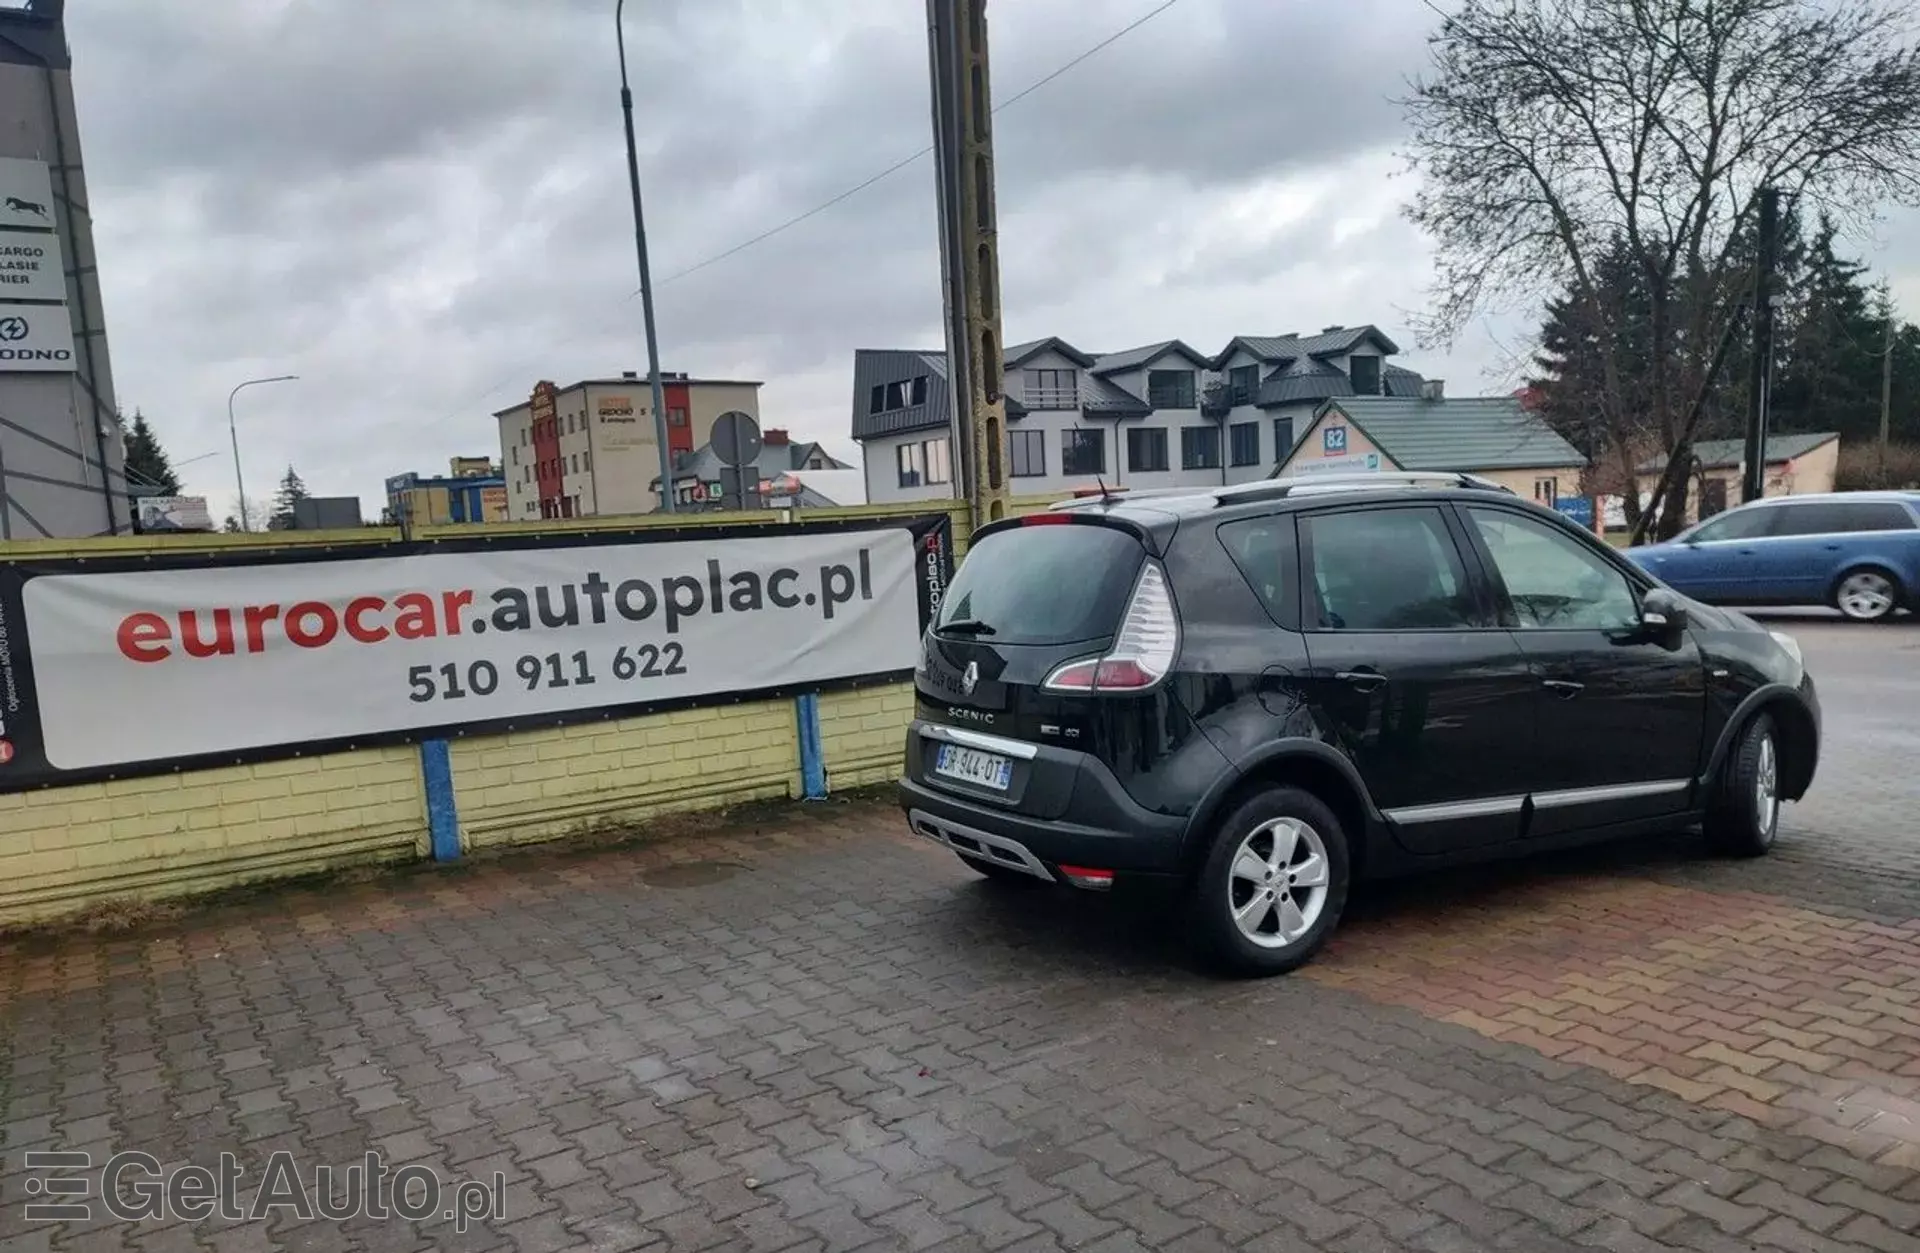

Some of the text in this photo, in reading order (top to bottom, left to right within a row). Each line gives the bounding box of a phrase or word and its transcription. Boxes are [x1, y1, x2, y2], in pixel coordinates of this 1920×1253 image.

[1327, 430, 1344, 448] 82
[117, 548, 873, 662] eurocar.autoplac.pl
[408, 641, 687, 702] 510 911 622
[947, 706, 994, 724] SCENIC
